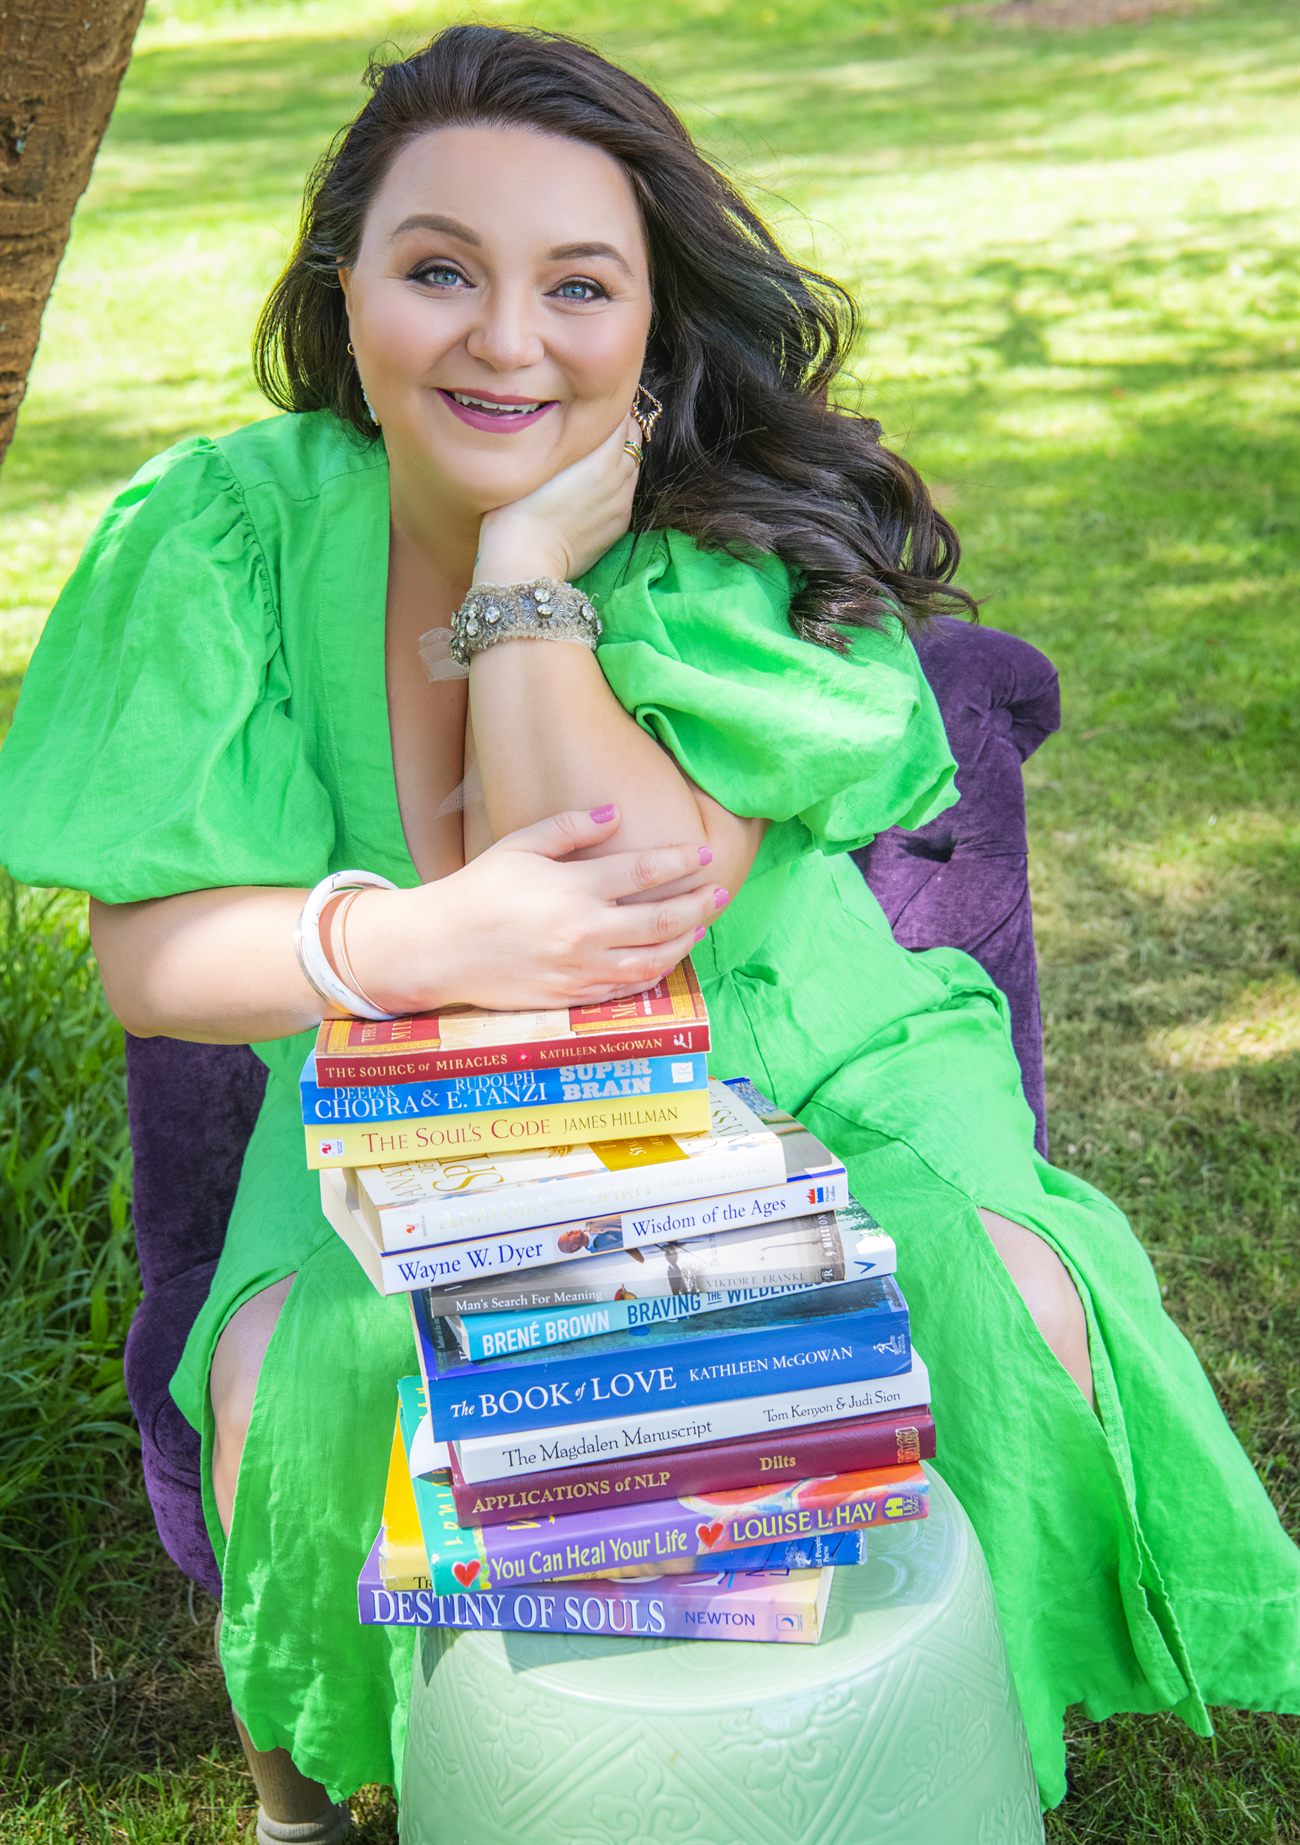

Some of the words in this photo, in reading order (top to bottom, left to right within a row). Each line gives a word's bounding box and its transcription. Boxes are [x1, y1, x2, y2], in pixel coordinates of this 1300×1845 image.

[540, 1046, 597, 1060] KATHLEEN
[599, 1038, 663, 1054] McGOWAN
[326, 1067, 356, 1078] THE
[359, 1063, 415, 1077] SOURCE
[418, 1063, 430, 1072] of
[436, 1054, 508, 1071] MIRACLES
[455, 1071, 536, 1091] RUDOLPH
[559, 1058, 652, 1083] SUPER
[314, 1095, 419, 1119] CHOPRA
[420, 1089, 440, 1107] &
[334, 1085, 397, 1100] DEEPAK
[447, 1090, 467, 1110] E.
[467, 1082, 548, 1107] TANZI
[562, 1077, 651, 1101] BRAIN
[563, 1114, 607, 1134] JAMES
[611, 1106, 679, 1127] HILLMAN
[632, 1213, 696, 1237] Wisdom
[702, 1207, 720, 1225] of
[723, 1203, 746, 1221] the
[751, 1197, 786, 1217] Ages
[397, 1260, 462, 1282] Wayne
[466, 1248, 492, 1268] W.
[498, 1242, 543, 1266] Dyer
[455, 1298, 488, 1312] Man's
[491, 1295, 528, 1309] Search
[531, 1293, 550, 1305] For
[554, 1289, 602, 1303] Meaning
[627, 1293, 701, 1325] BRAVING
[707, 1291, 722, 1302] THE
[482, 1321, 541, 1356] BRENÉ
[545, 1309, 610, 1343] BROWN
[689, 1358, 769, 1382] KATHLEEN
[772, 1346, 854, 1370] McGOWAN
[450, 1399, 475, 1418] The
[478, 1382, 573, 1418] BOOK
[574, 1381, 587, 1401] of
[590, 1366, 677, 1401] LOVE
[763, 1409, 789, 1423] Tom
[791, 1403, 834, 1418] Kenyon
[836, 1397, 847, 1410] &
[848, 1393, 873, 1409] Judi
[875, 1389, 901, 1404] Sion
[502, 1448, 537, 1468] The
[539, 1435, 619, 1462] Magdalen
[622, 1421, 713, 1447] Manuscript
[760, 1456, 797, 1471] Dilts
[471, 1480, 611, 1514] APPLICATIONS
[615, 1478, 632, 1493] of
[634, 1471, 671, 1490] NLP
[733, 1510, 812, 1542] LOUISE
[817, 1511, 833, 1529] L.
[836, 1502, 876, 1524] HAY
[491, 1557, 525, 1581] You
[529, 1551, 563, 1573] Can
[566, 1541, 606, 1568] Heal
[609, 1535, 651, 1561] Your
[655, 1528, 688, 1555] Life
[371, 1589, 506, 1627] DESTINY
[513, 1594, 557, 1629] OF
[564, 1596, 666, 1634] SOULS
[684, 1610, 756, 1626] NEWTON
